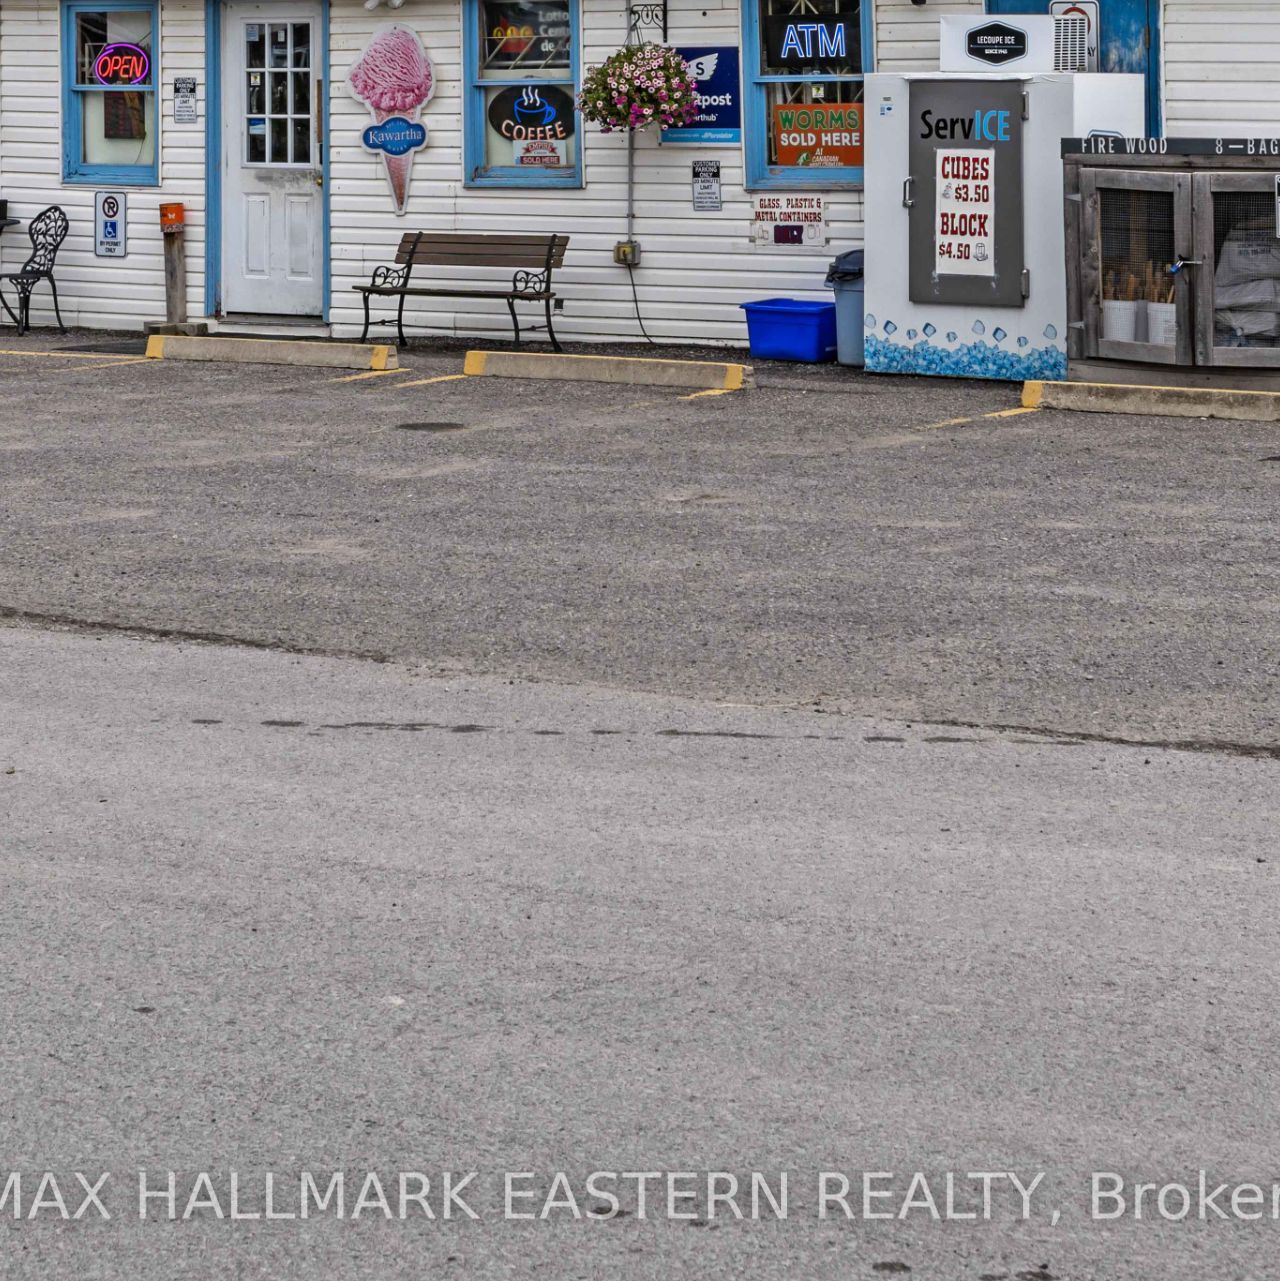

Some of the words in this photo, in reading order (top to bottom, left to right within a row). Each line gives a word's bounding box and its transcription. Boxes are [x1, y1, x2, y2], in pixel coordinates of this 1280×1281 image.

[541, 40, 555, 51] de
[781, 24, 846, 58] ATM
[977, 36, 1003, 44] LECOUPE
[99, 56, 143, 77] OPEN
[779, 109, 859, 130] WORMS
[920, 109, 1010, 141] ServICE
[369, 129, 422, 144] Kawartha
[502, 120, 566, 141] COFFEE
[780, 133, 816, 146] SOLD
[821, 133, 860, 146] HERE
[1081, 137, 1115, 154] FIRE
[1125, 137, 1168, 154] WOOD
[942, 156, 989, 180] CUBES
[955, 184, 989, 202] $3.50
[786, 198, 814, 209] PLASTIC
[755, 211, 777, 221] METAL
[779, 212, 822, 222] CONTAINERS
[941, 213, 988, 237] BLOCK
[939, 241, 970, 260] $4.50
